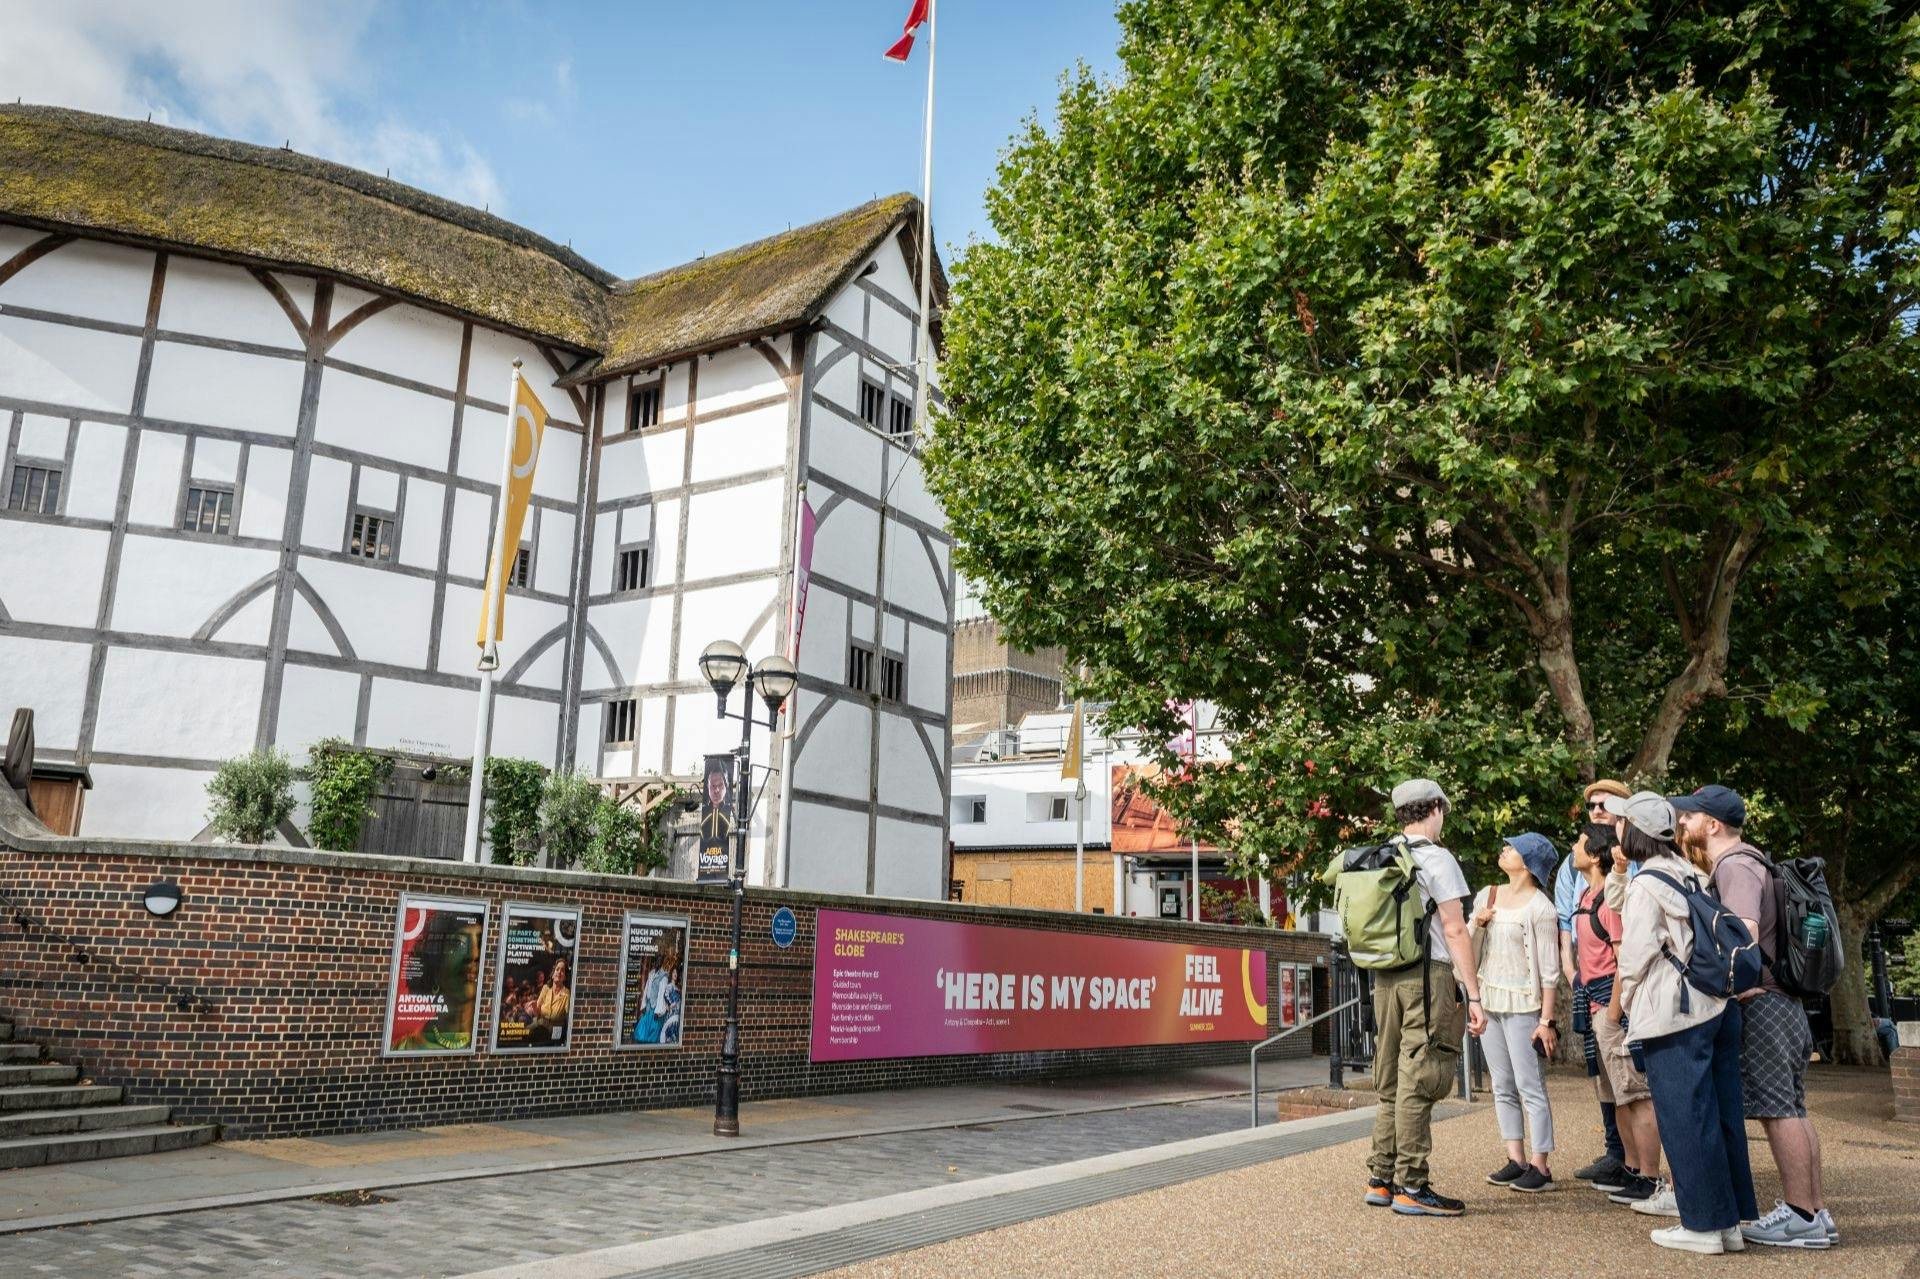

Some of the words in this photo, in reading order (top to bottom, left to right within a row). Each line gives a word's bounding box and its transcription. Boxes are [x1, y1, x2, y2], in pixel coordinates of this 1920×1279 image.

[700, 852, 728, 866] Voyage
[630, 928, 648, 936] MUCH
[649, 929, 663, 937] ADO
[835, 928, 904, 945] SHAKESPEARE'S
[630, 936, 653, 944] ABOUT
[507, 943, 546, 951] CAPTIVATING
[630, 944, 659, 952] NOTHING
[834, 944, 865, 957] GLOBE
[506, 958, 529, 966] UNIQUE
[833, 968, 843, 978] Epic
[844, 969, 861, 978] theatre
[861, 969, 873, 978] from
[1185, 954, 1221, 983] FEEL
[832, 980, 850, 988] Guided
[936, 967, 1015, 1010] ‘HERE
[1021, 974, 1045, 1011] IS
[1051, 976, 1086, 1010] MY
[1089, 976, 1157, 1010] SPACE’
[398, 994, 436, 1004] ANTONY
[437, 995, 445, 1003] &
[1179, 988, 1223, 1016] ALIVE
[397, 1004, 449, 1013] CLEOPATRA
